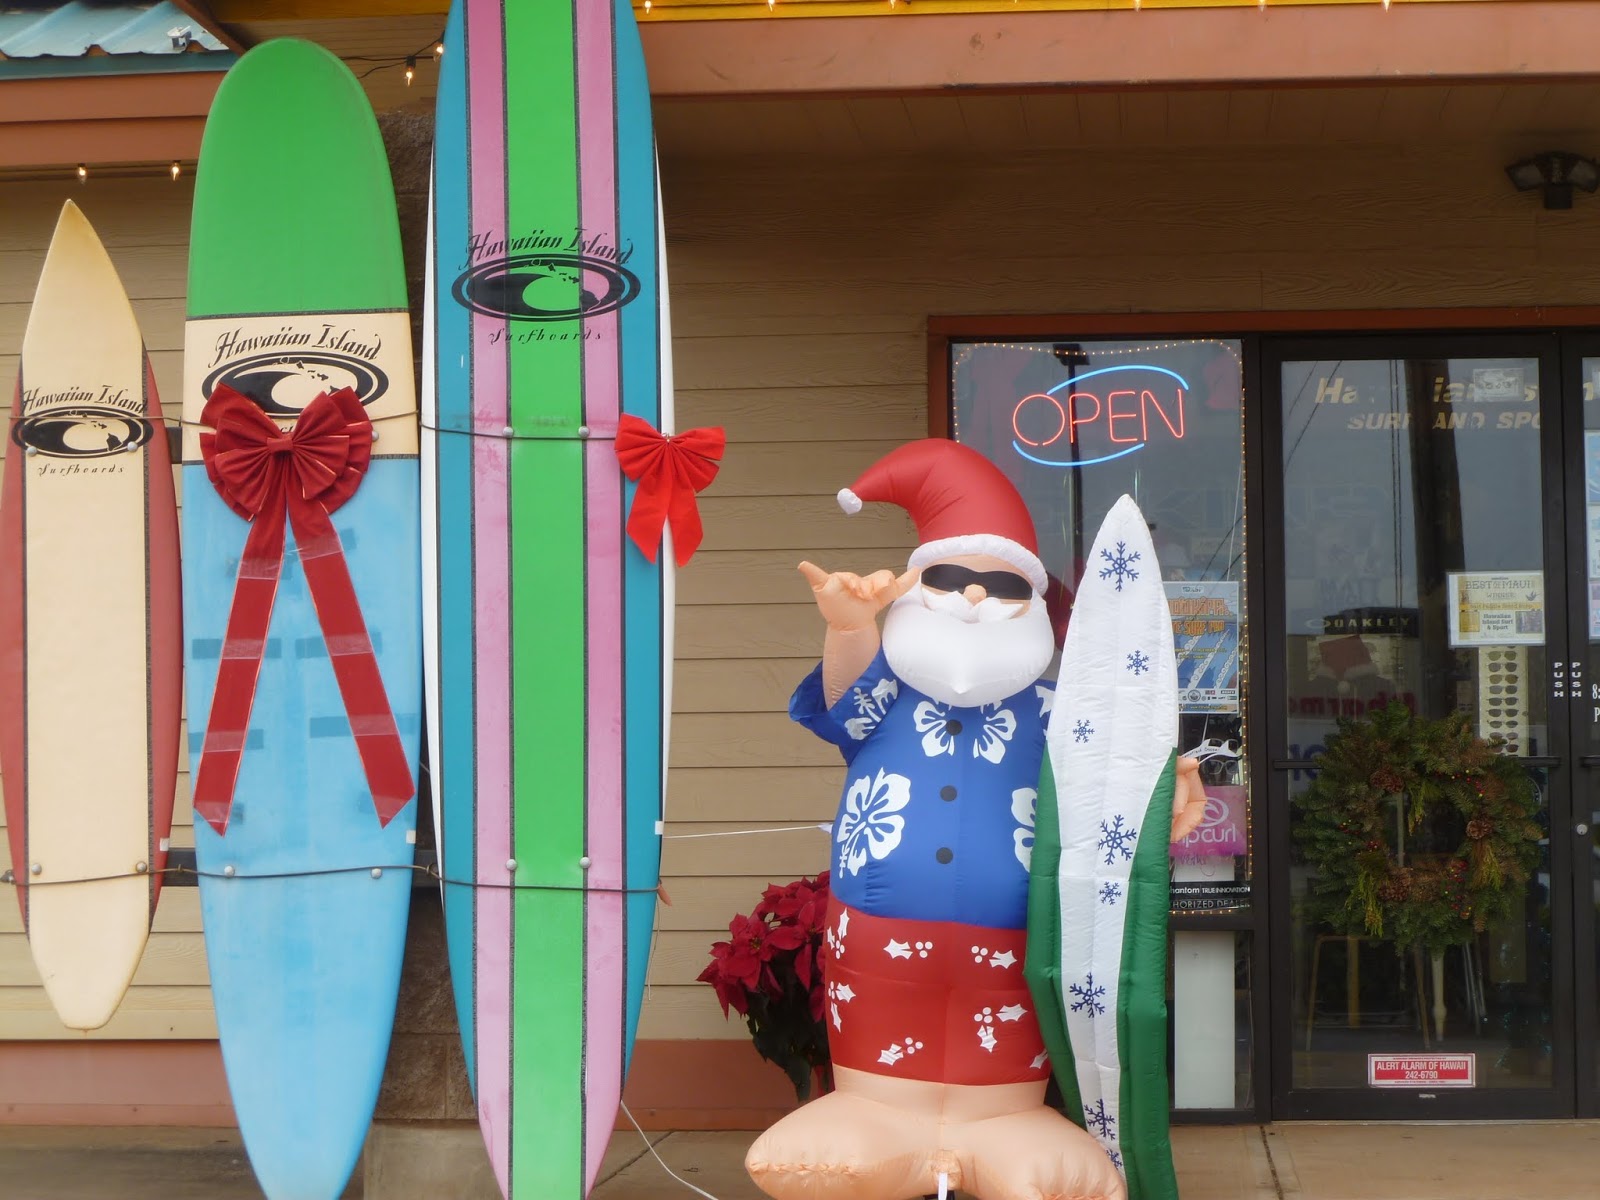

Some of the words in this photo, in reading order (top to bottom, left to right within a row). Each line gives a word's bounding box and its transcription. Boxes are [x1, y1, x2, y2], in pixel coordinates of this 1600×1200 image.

[458, 229, 563, 270] Hawaiian
[563, 227, 634, 265] Island
[488, 328, 602, 344] Surfboards
[208, 326, 311, 368] Hawaiian
[313, 324, 382, 360] Island
[22, 386, 94, 412] Hawaiian
[94, 384, 148, 413] Island
[1012, 388, 1184, 446] OPEN
[38, 464, 125, 476] Surfboards
[1502, 580, 1532, 589] MAUI
[1334, 618, 1410, 628] OAKLEY
[1553, 662, 1564, 698] PUSH
[1571, 662, 1582, 698] PUSH
[1170, 886, 1200, 894] hantom
[1173, 900, 1214, 909] HORIZED
[1377, 1062, 1400, 1071] ALERT
[1401, 1061, 1427, 1070] ALARM
[1428, 1061, 1438, 1070] OF
[1440, 1061, 1466, 1070] HAWAII
[1405, 1071, 1438, 1079] 242-6790
